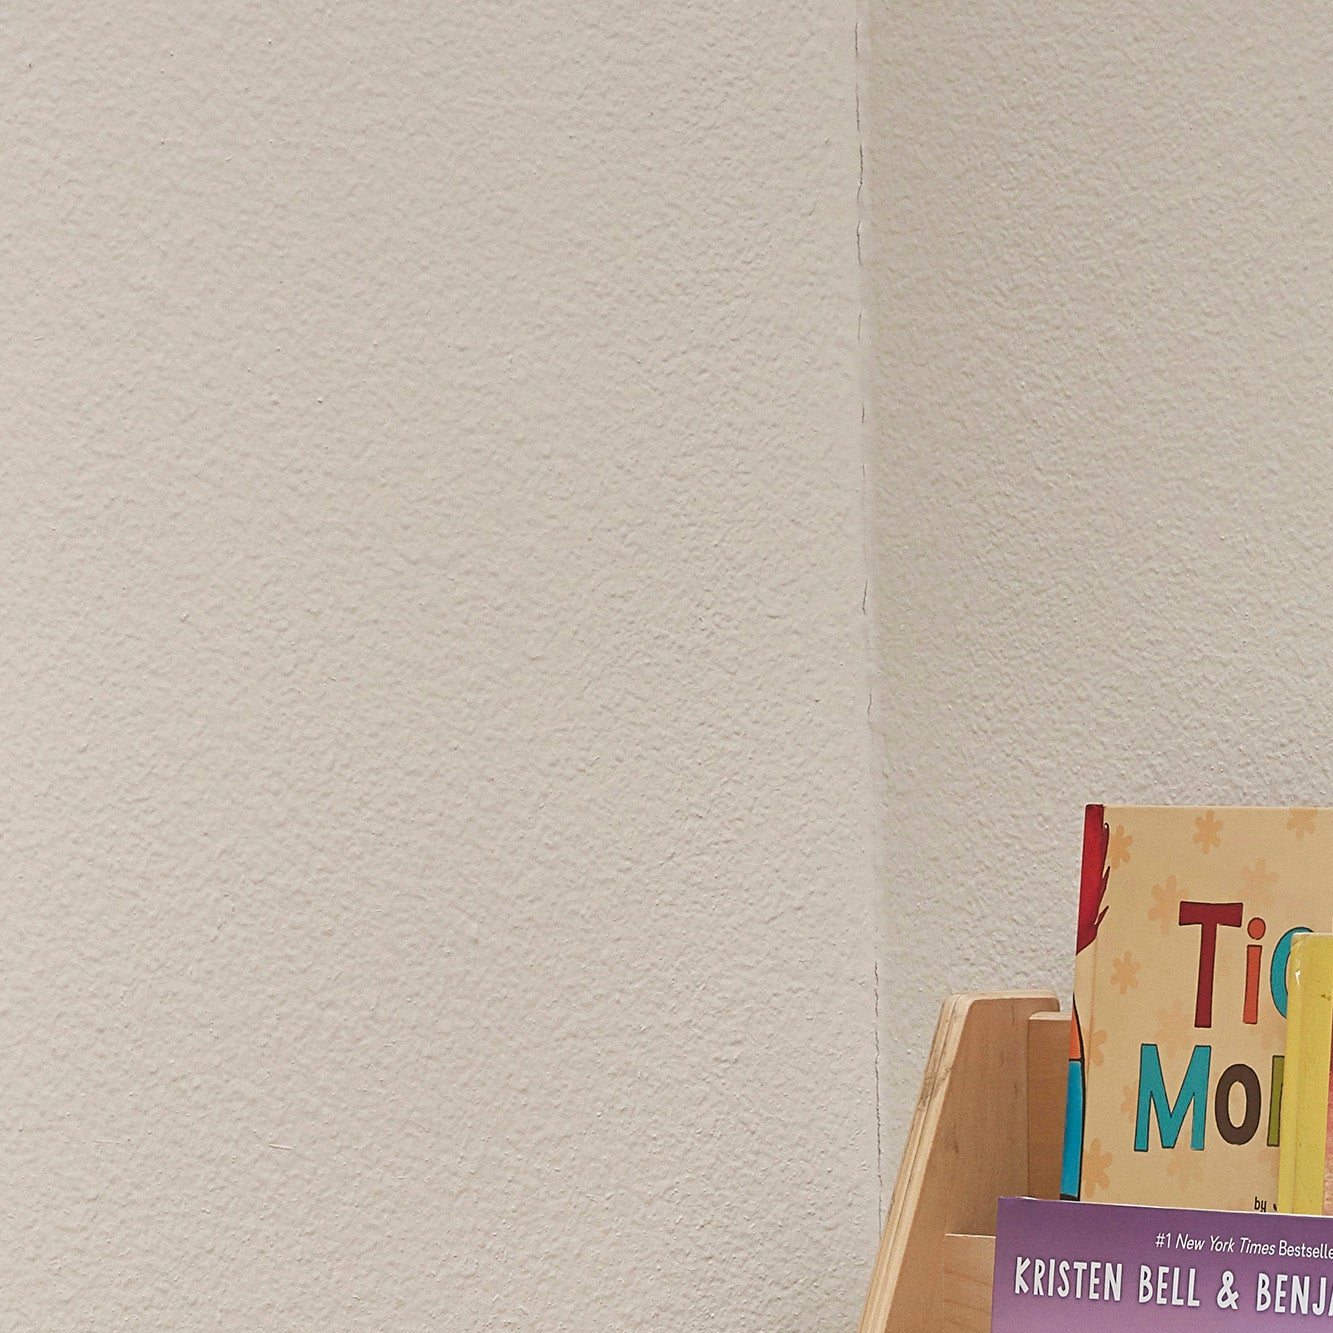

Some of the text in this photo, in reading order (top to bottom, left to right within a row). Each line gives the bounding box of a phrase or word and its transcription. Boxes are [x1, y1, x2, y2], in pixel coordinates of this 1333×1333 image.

[1155, 1232, 1171, 1249] #1
[1176, 1233, 1205, 1251] New
[1209, 1235, 1235, 1253] York
[1240, 1237, 1276, 1256] Times
[1014, 1256, 1123, 1302] KRISTEN
[1139, 1265, 1200, 1307] BELL
[1216, 1270, 1239, 1310] &
